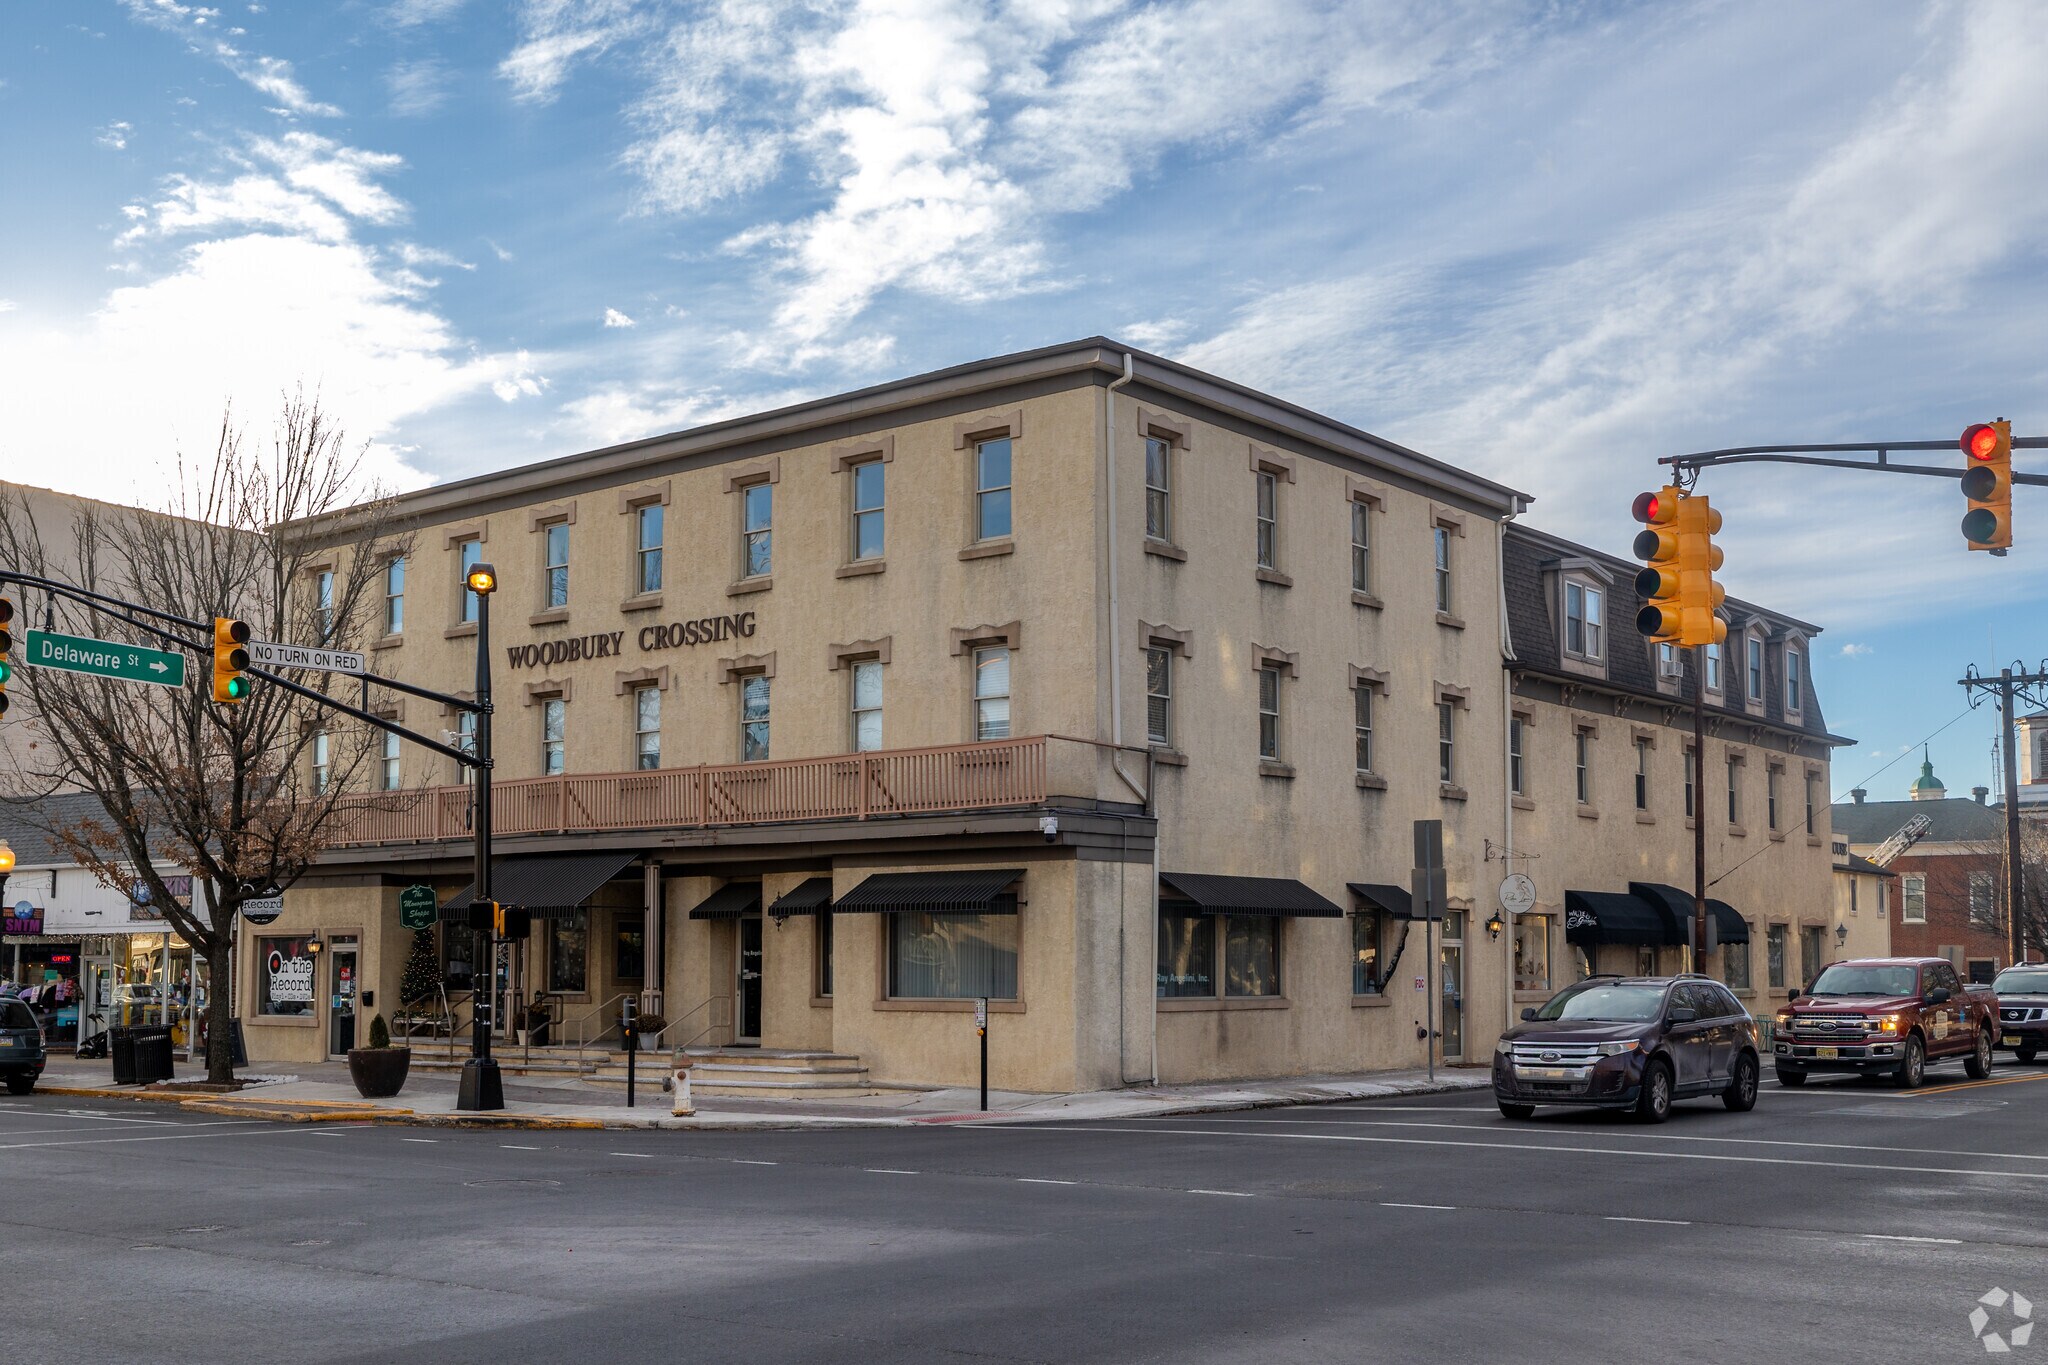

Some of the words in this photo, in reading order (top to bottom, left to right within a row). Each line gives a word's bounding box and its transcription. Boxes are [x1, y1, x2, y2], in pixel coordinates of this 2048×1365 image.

[507, 631, 624, 669] WOODBURY
[638, 611, 756, 651] CROSSING
[42, 640, 120, 669] Delaware
[127, 654, 139, 666] St
[255, 646, 273, 660] NO
[278, 649, 309, 664] TURN
[314, 653, 330, 666] ON
[335, 655, 358, 669] RED
[243, 896, 283, 909] Record
[6, 919, 40, 932] SNTM
[1446, 918, 1451, 932] 3
[52, 955, 72, 963] OPEN
[269, 953, 289, 974] On
[292, 957, 312, 974] the
[271, 975, 311, 991] Record
[1156, 974, 1168, 984] Ray
[1199, 973, 1210, 982] Inc.
